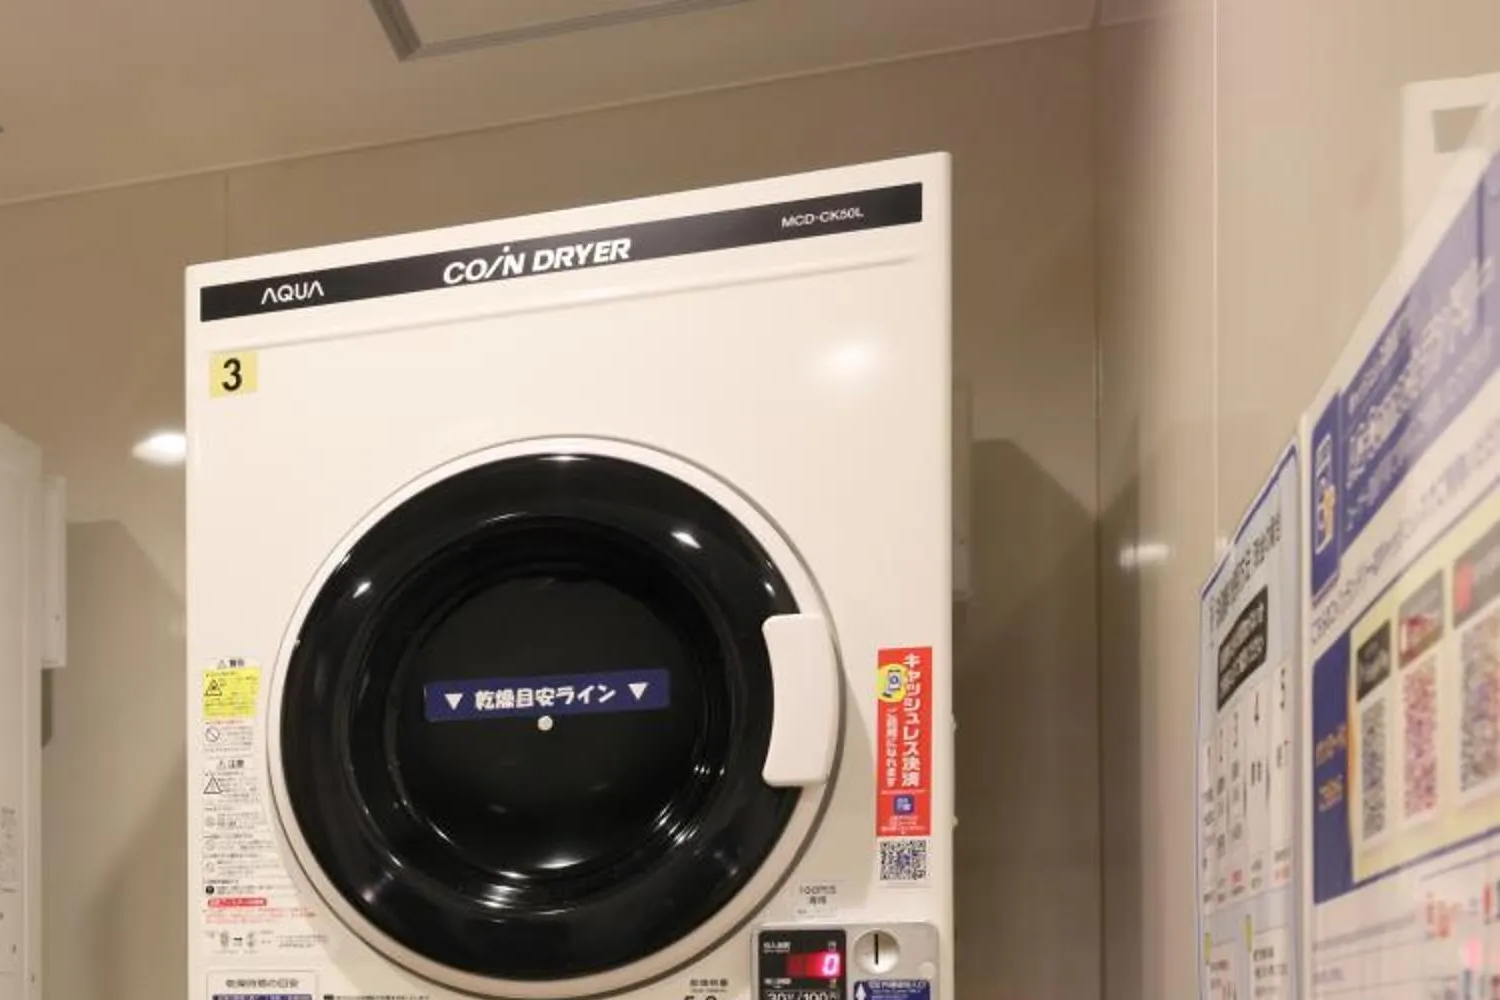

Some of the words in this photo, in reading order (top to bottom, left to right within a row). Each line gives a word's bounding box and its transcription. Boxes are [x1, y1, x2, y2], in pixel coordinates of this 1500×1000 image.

[261, 280, 325, 305] AQUA
[531, 237, 632, 273] DRYER
[780, 206, 865, 230] MCD-CK50L
[221, 357, 243, 392] 3
[474, 684, 617, 711] 乾燥目安ライン
[902, 653, 921, 788] キャッシュレス決済
[822, 952, 841, 978] 0
